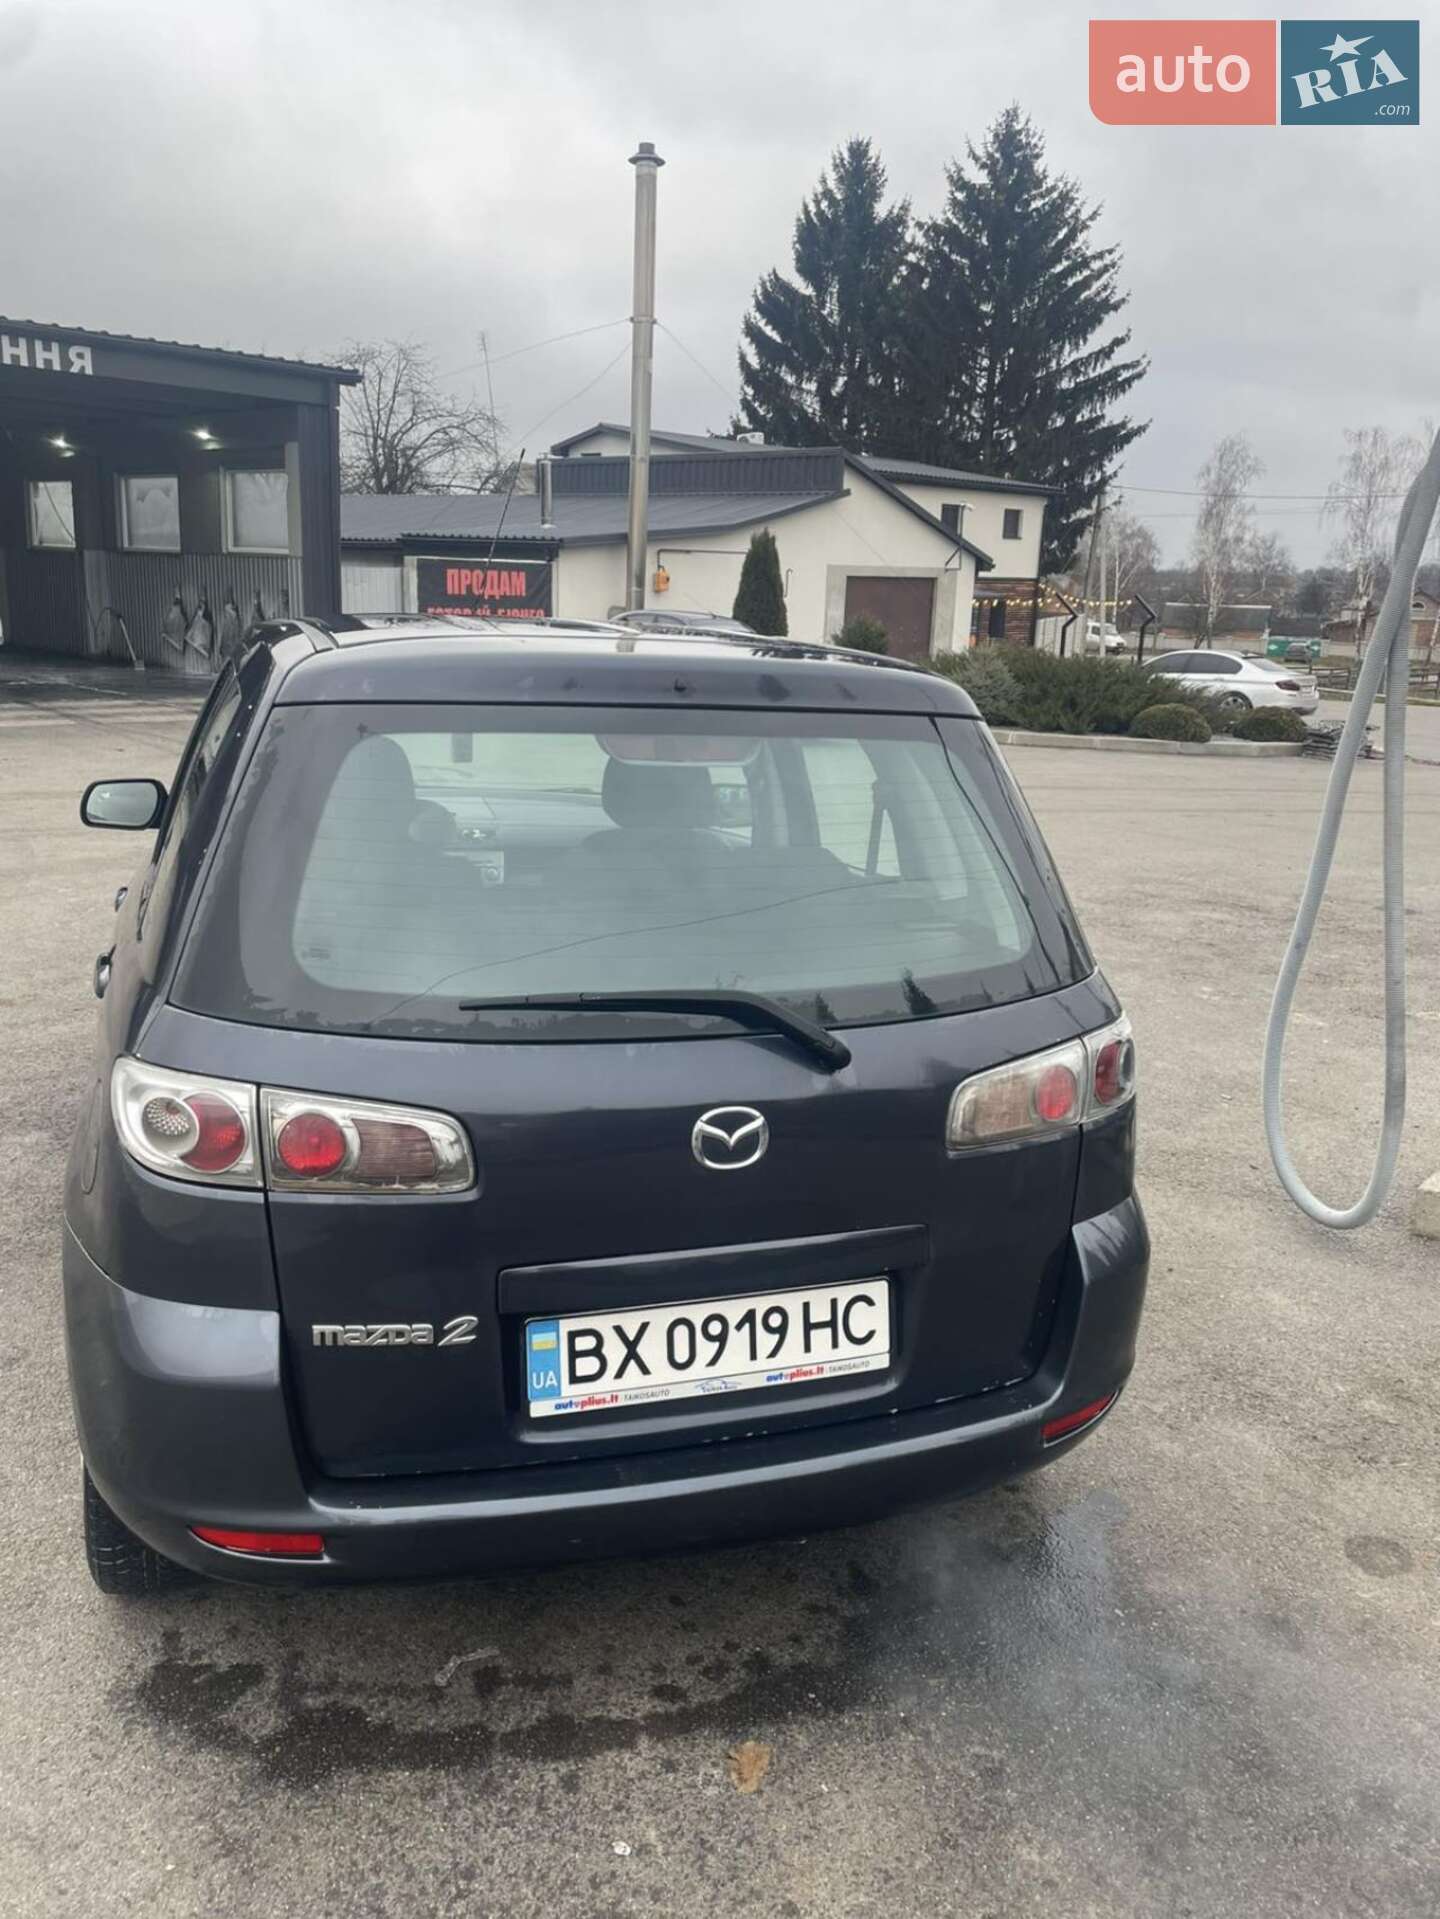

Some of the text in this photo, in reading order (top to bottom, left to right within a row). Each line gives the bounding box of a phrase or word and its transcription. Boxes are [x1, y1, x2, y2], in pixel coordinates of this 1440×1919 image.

[446, 568, 526, 599] ПРОДАМ
[438, 1315, 479, 1346] 2
[567, 1294, 877, 1386] BX 0919 HC
[532, 1372, 558, 1389] UA
